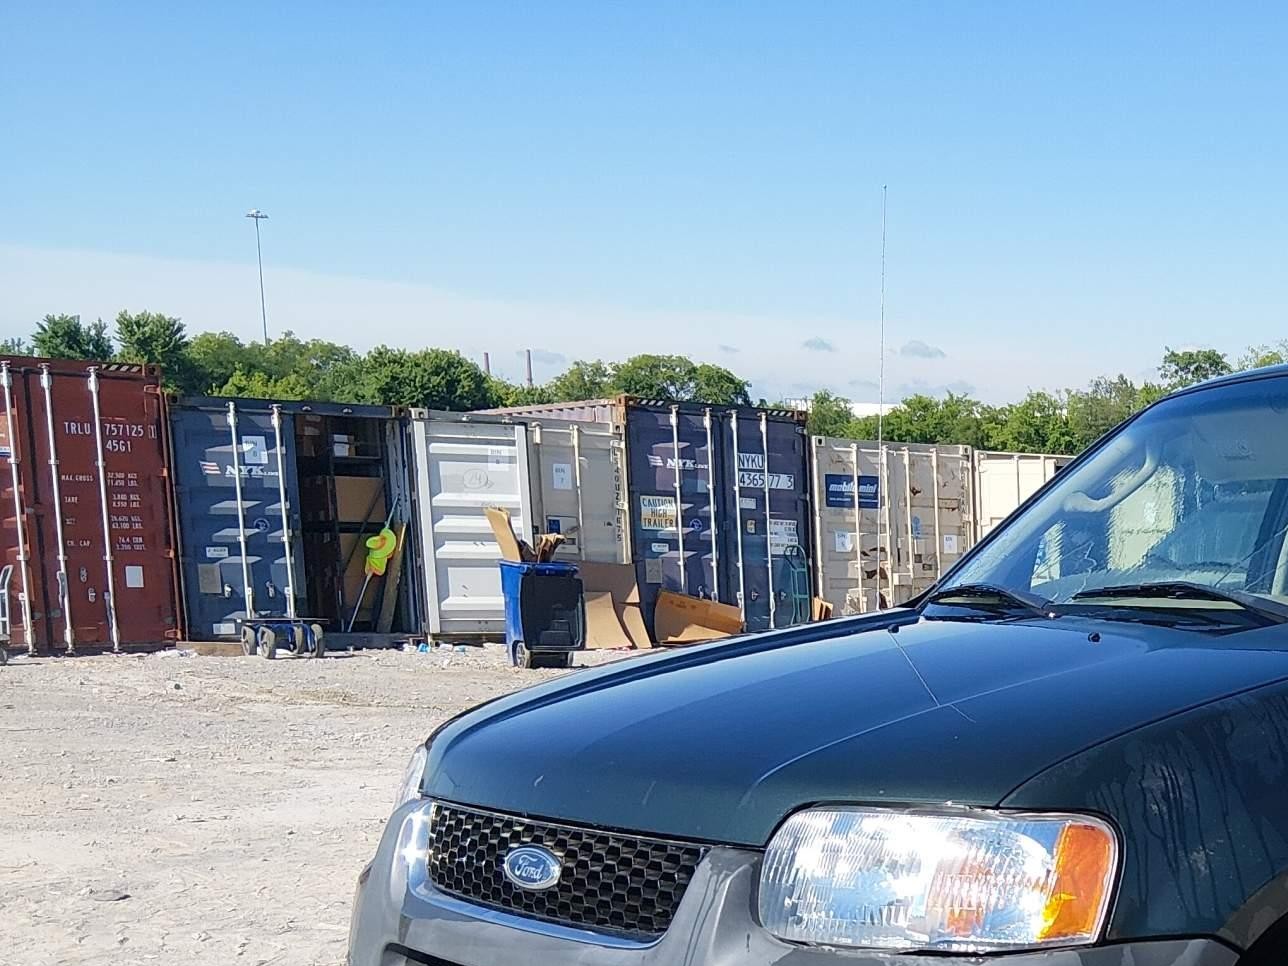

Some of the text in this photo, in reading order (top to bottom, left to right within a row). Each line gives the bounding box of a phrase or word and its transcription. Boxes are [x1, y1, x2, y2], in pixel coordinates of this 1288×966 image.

[64, 422, 91, 434] TRLU
[104, 423, 144, 437] 757125
[665, 458, 695, 468] NYK
[738, 454, 764, 468] NYKU
[225, 465, 264, 475] NYK
[859, 483, 878, 493] mini
[642, 498, 674, 507] CAUTION
[650, 509, 668, 518] HIGH
[644, 518, 674, 528] TRAILER
[515, 855, 545, 880] Ford
